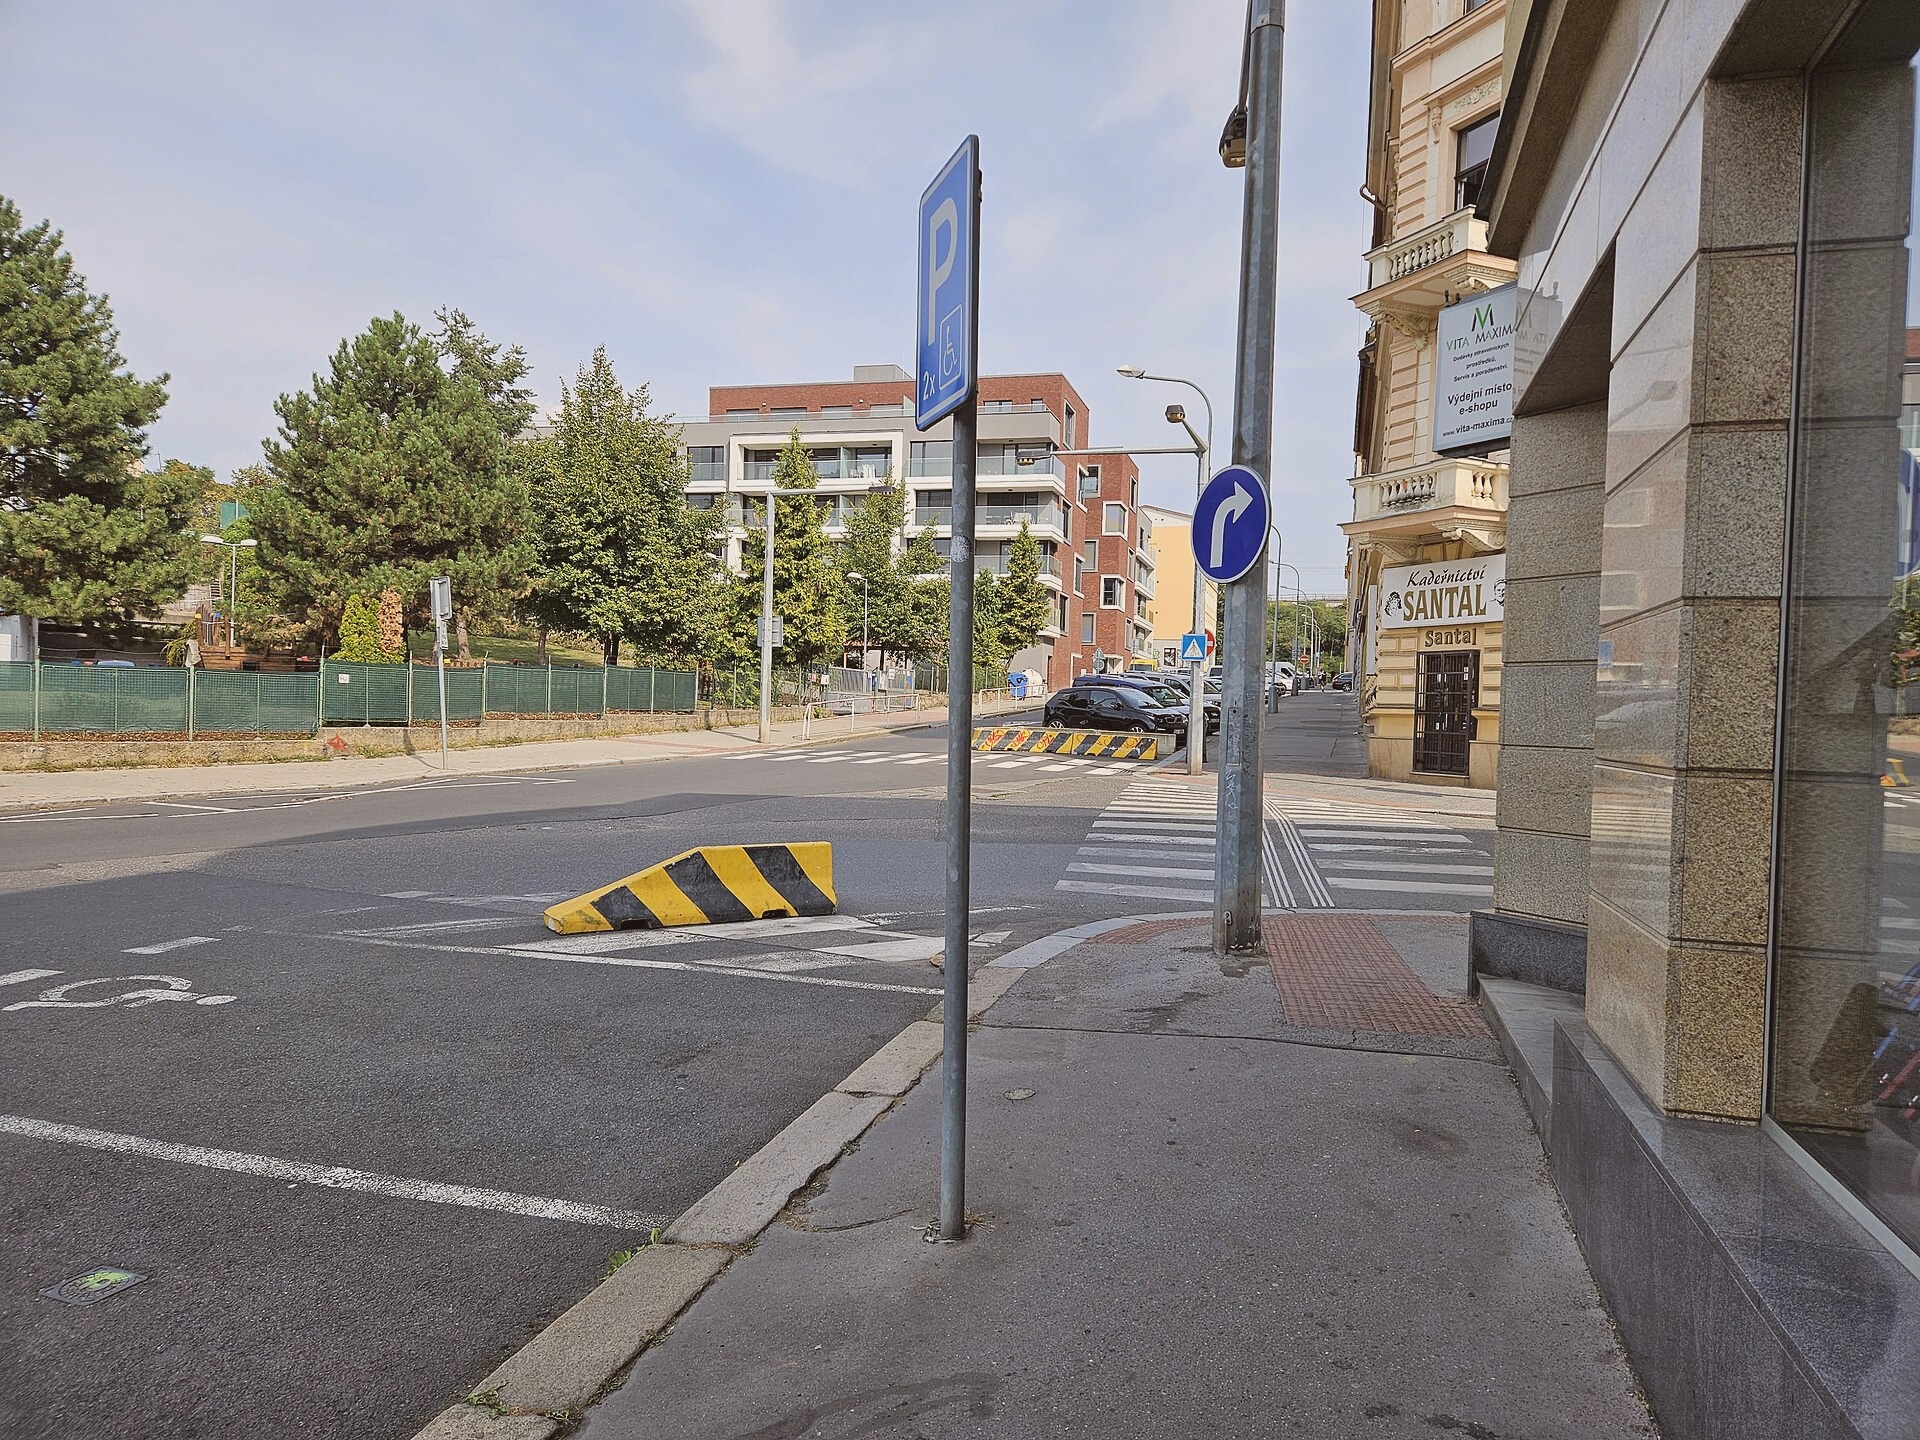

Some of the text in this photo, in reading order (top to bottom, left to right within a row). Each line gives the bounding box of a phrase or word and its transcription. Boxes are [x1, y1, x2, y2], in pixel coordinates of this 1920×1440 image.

[928, 197, 958, 346] P
[1446, 338, 1469, 351] VITA
[1452, 342, 1510, 363] Dodávky zdravotnických
[923, 371, 936, 401] 2x
[1453, 373, 1470, 383] Servis
[1447, 383, 1513, 406] Výdejní místo
[1459, 400, 1498, 415] e-shopu
[1442, 417, 1513, 437] www.vita-maxima.cz
[1407, 564, 1488, 588] Kadeřnictví
[1403, 584, 1487, 621] SANTAL
[1425, 628, 1477, 647] Santal
